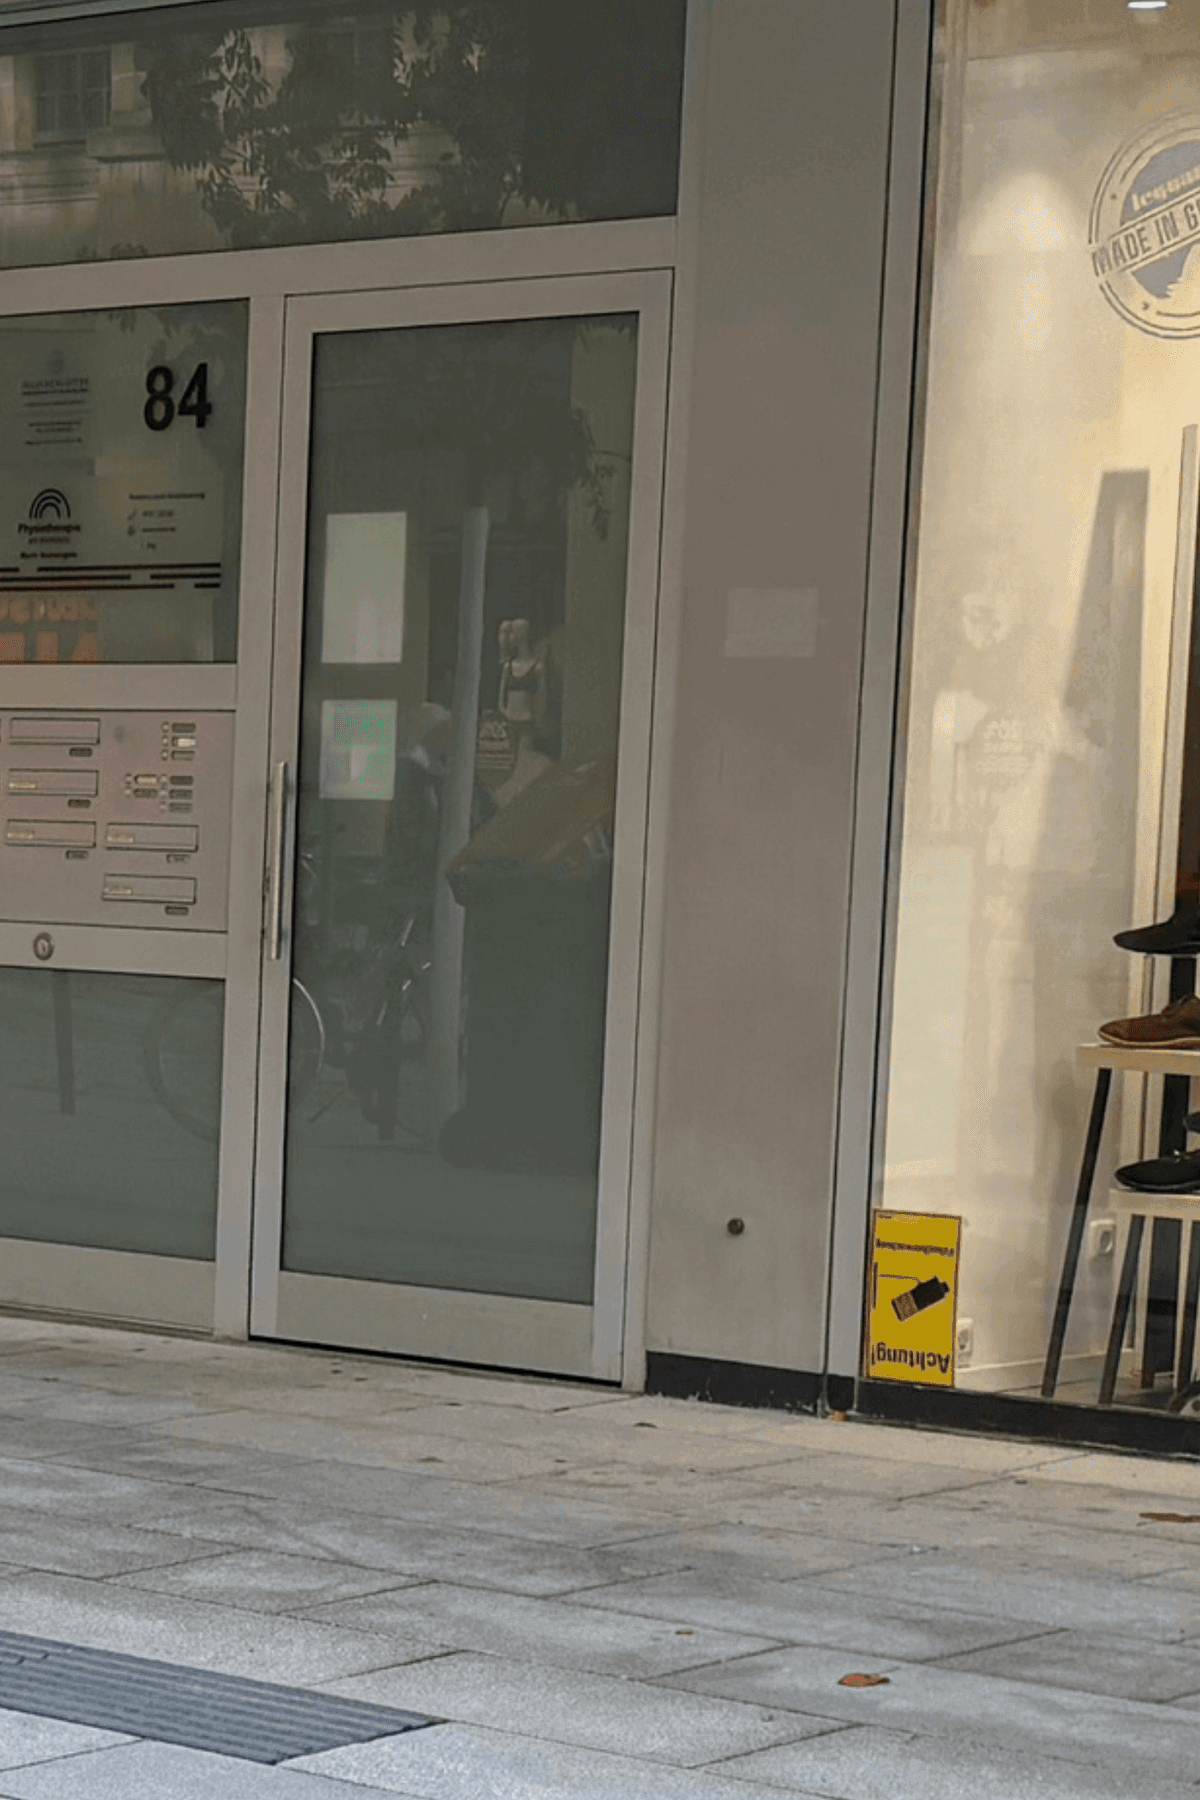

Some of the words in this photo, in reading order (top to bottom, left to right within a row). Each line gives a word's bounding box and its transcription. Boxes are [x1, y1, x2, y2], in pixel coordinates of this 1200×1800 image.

[1091, 226, 1152, 277] MADE
[1154, 210, 1180, 245] IN
[1183, 199, 1200, 230] G
[144, 363, 212, 431] 84
